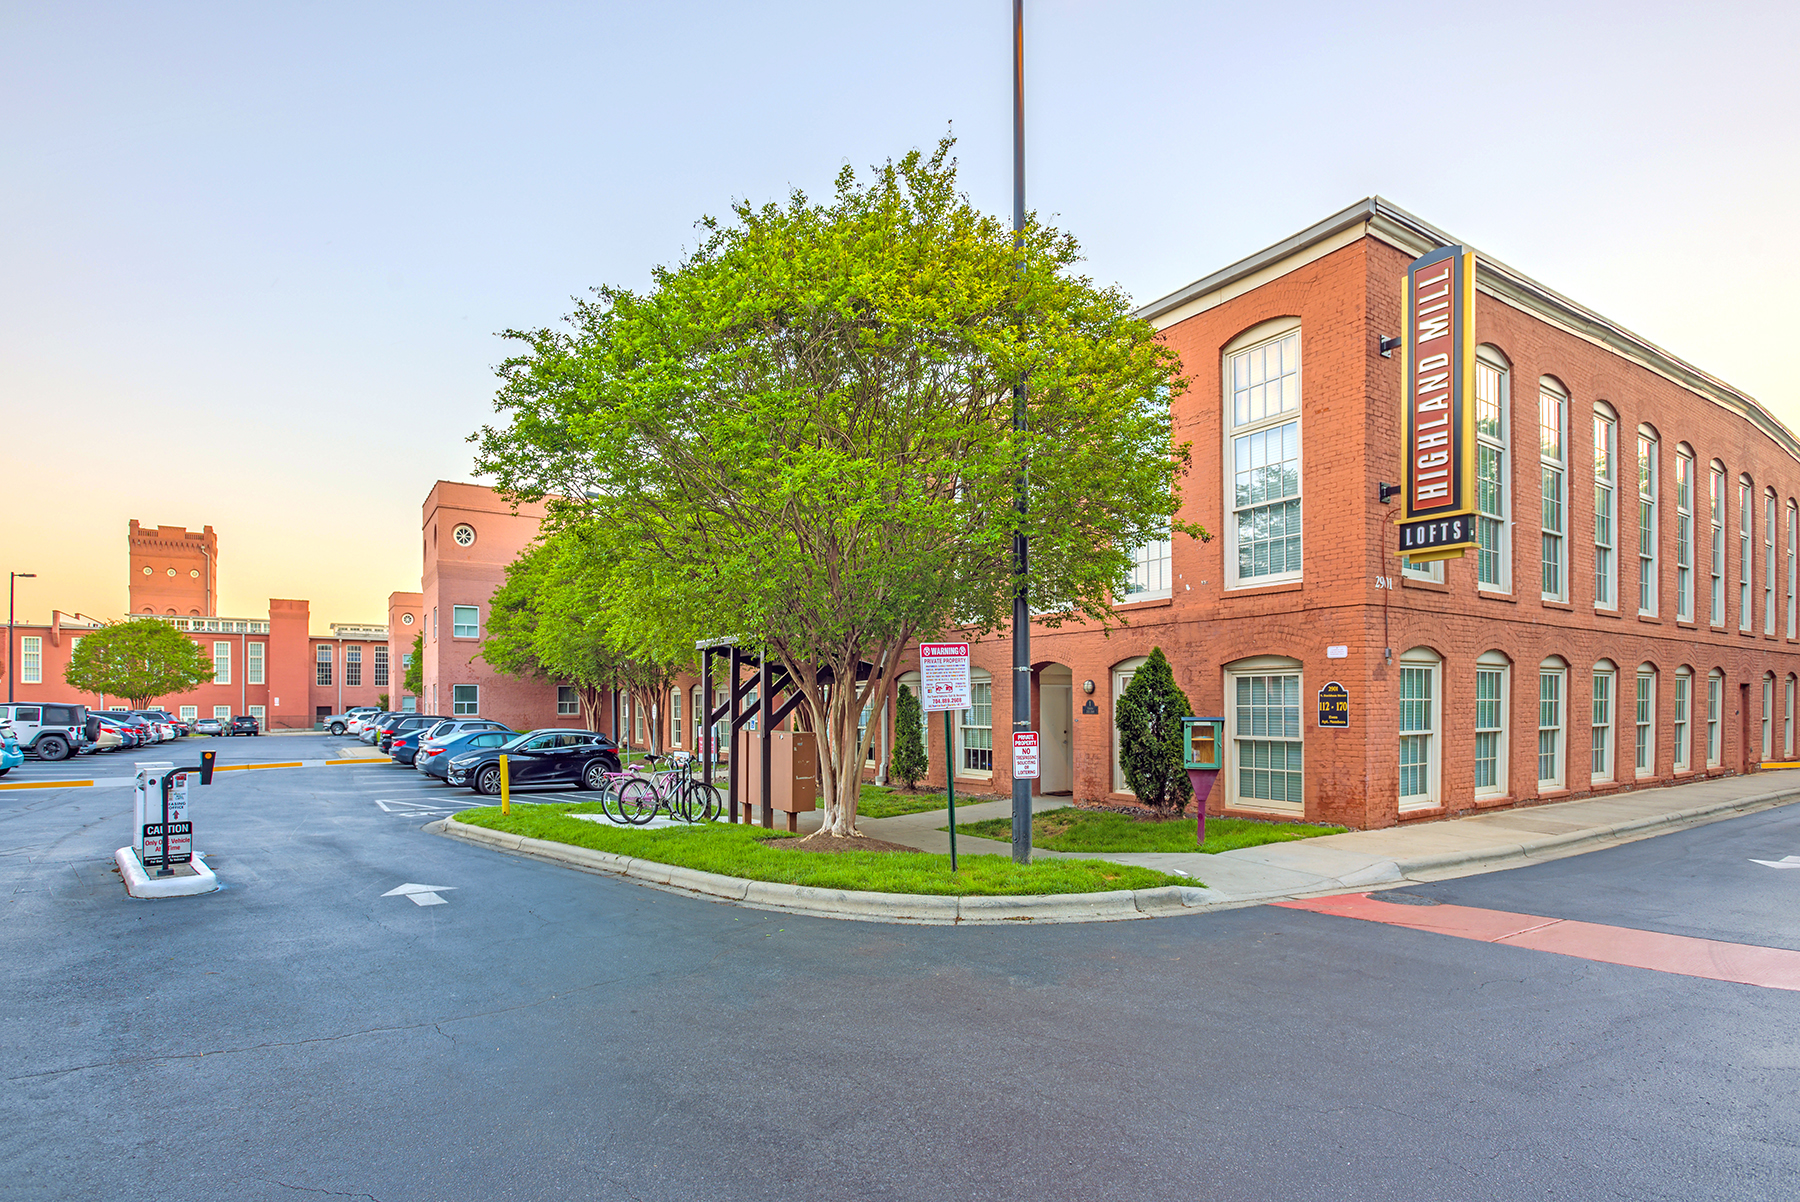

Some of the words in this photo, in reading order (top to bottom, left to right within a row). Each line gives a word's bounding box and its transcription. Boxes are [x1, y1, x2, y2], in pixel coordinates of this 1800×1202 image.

[1418, 267, 1449, 345] MILL
[1417, 352, 1449, 501] HIGHLAND
[1405, 520, 1461, 546] LOFTS
[1375, 575, 1393, 590] 2901
[931, 647, 958, 655] WARNING
[1319, 701, 1330, 711] 112
[1336, 701, 1348, 711] 170
